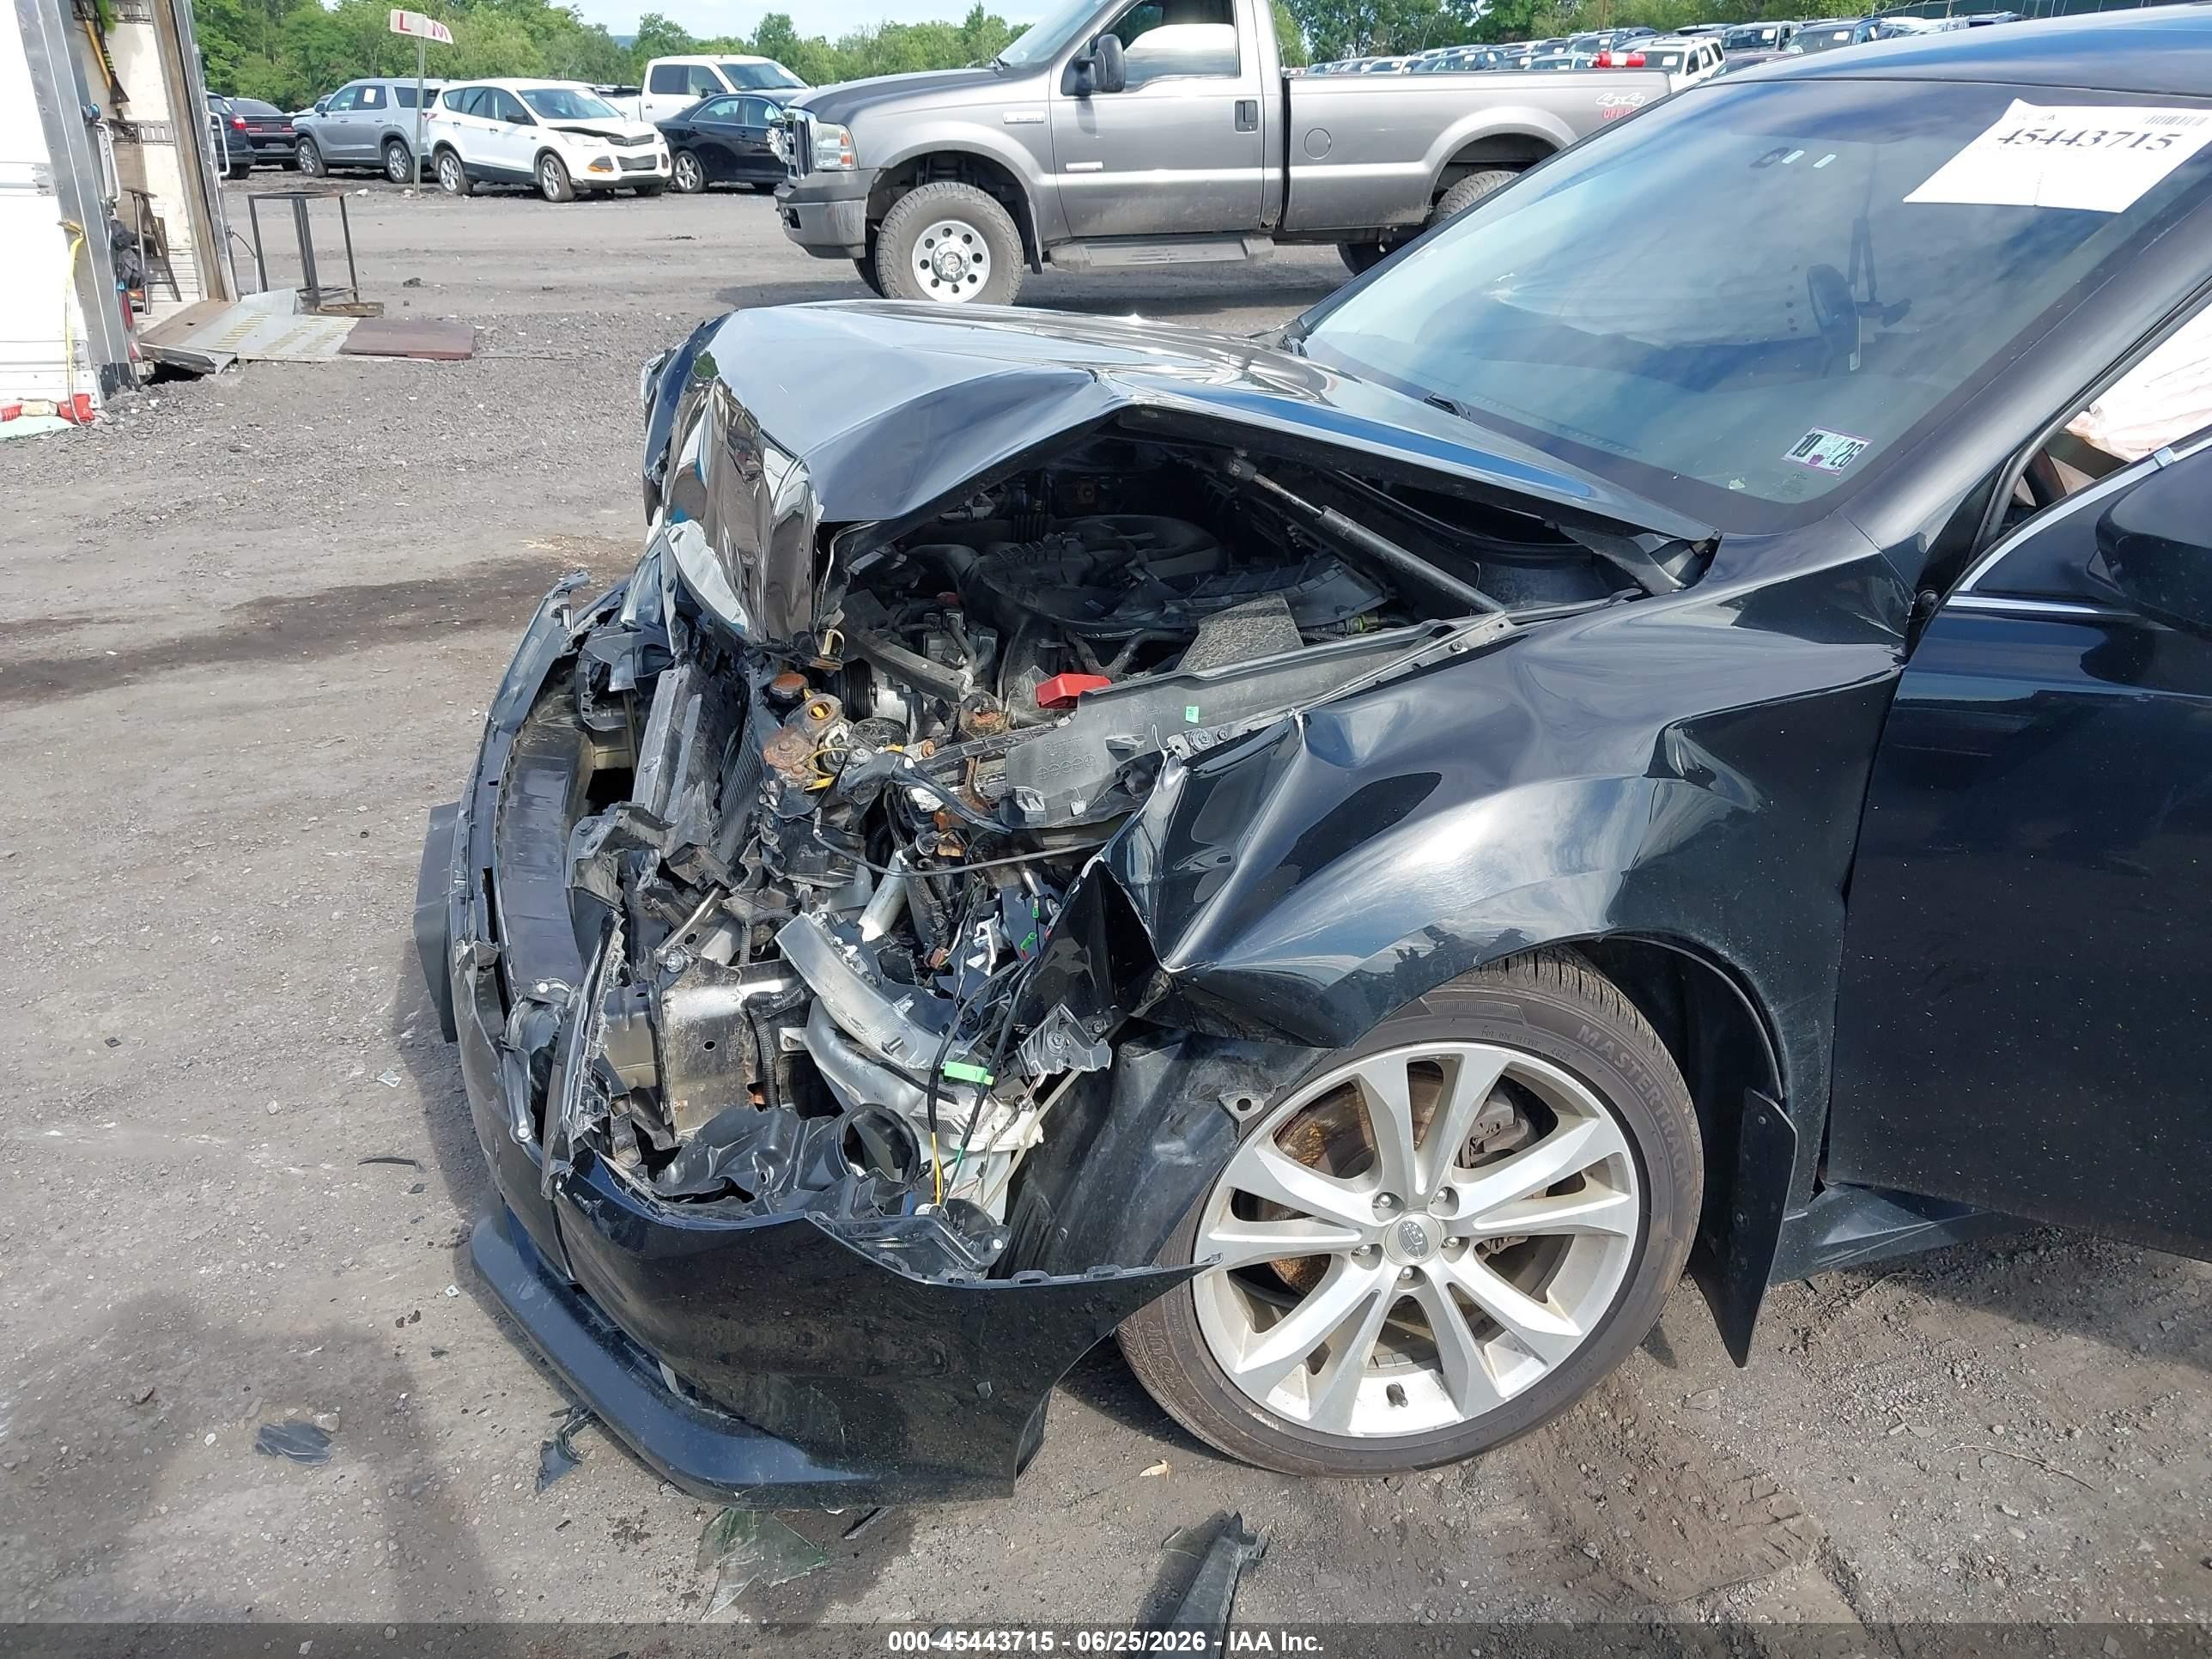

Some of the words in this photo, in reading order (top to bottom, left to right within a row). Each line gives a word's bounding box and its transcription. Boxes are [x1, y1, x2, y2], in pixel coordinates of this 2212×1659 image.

[399, 12, 411, 32] L
[432, 21, 448, 40] M
[1997, 128, 2183, 150] 45443715
[1791, 433, 1824, 458] 10
[1828, 441, 1865, 468] 26
